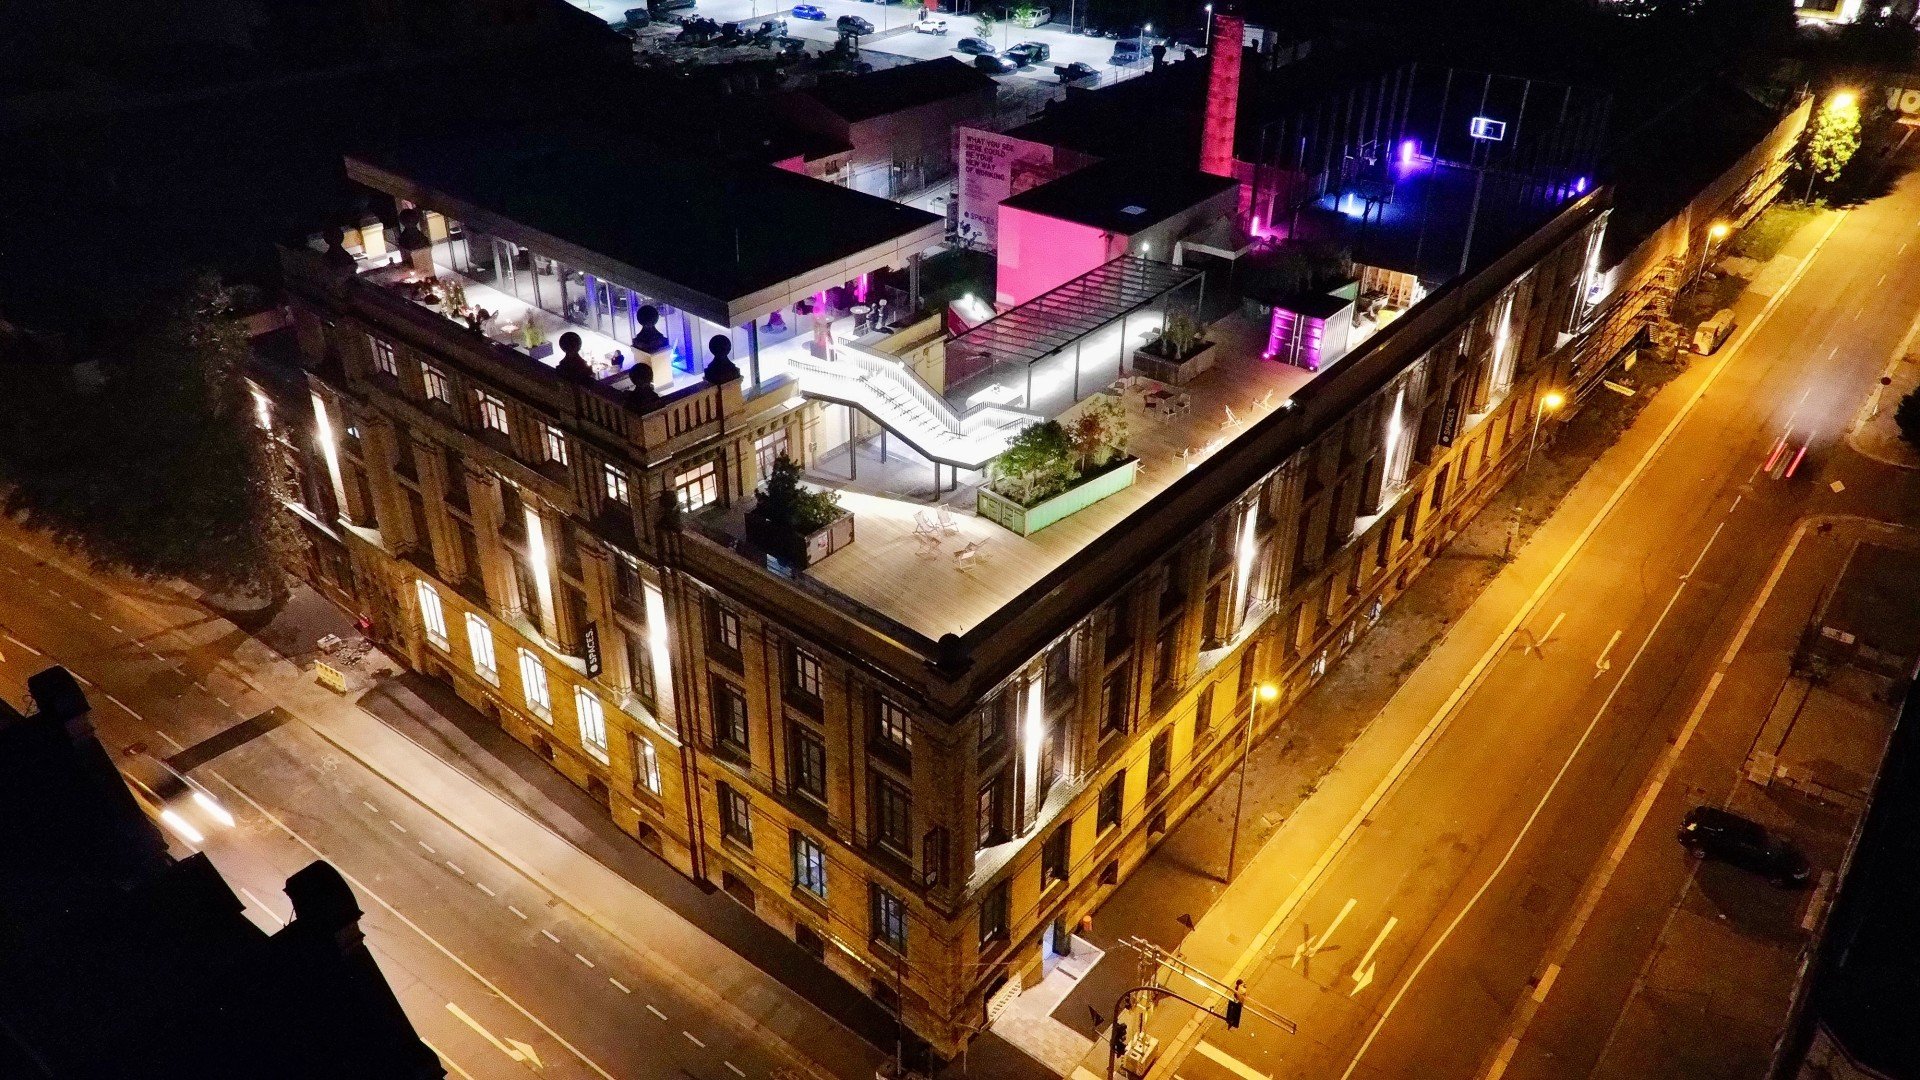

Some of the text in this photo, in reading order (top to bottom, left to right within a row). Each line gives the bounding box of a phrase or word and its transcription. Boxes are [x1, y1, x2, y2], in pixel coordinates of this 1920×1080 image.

[966, 136, 985, 145] WHAT
[987, 140, 1000, 148] YOU
[966, 143, 1005, 158] HERE COULD
[966, 158, 979, 166] NEW
[976, 153, 993, 163] YOUR
[975, 168, 1004, 181] WORKING
